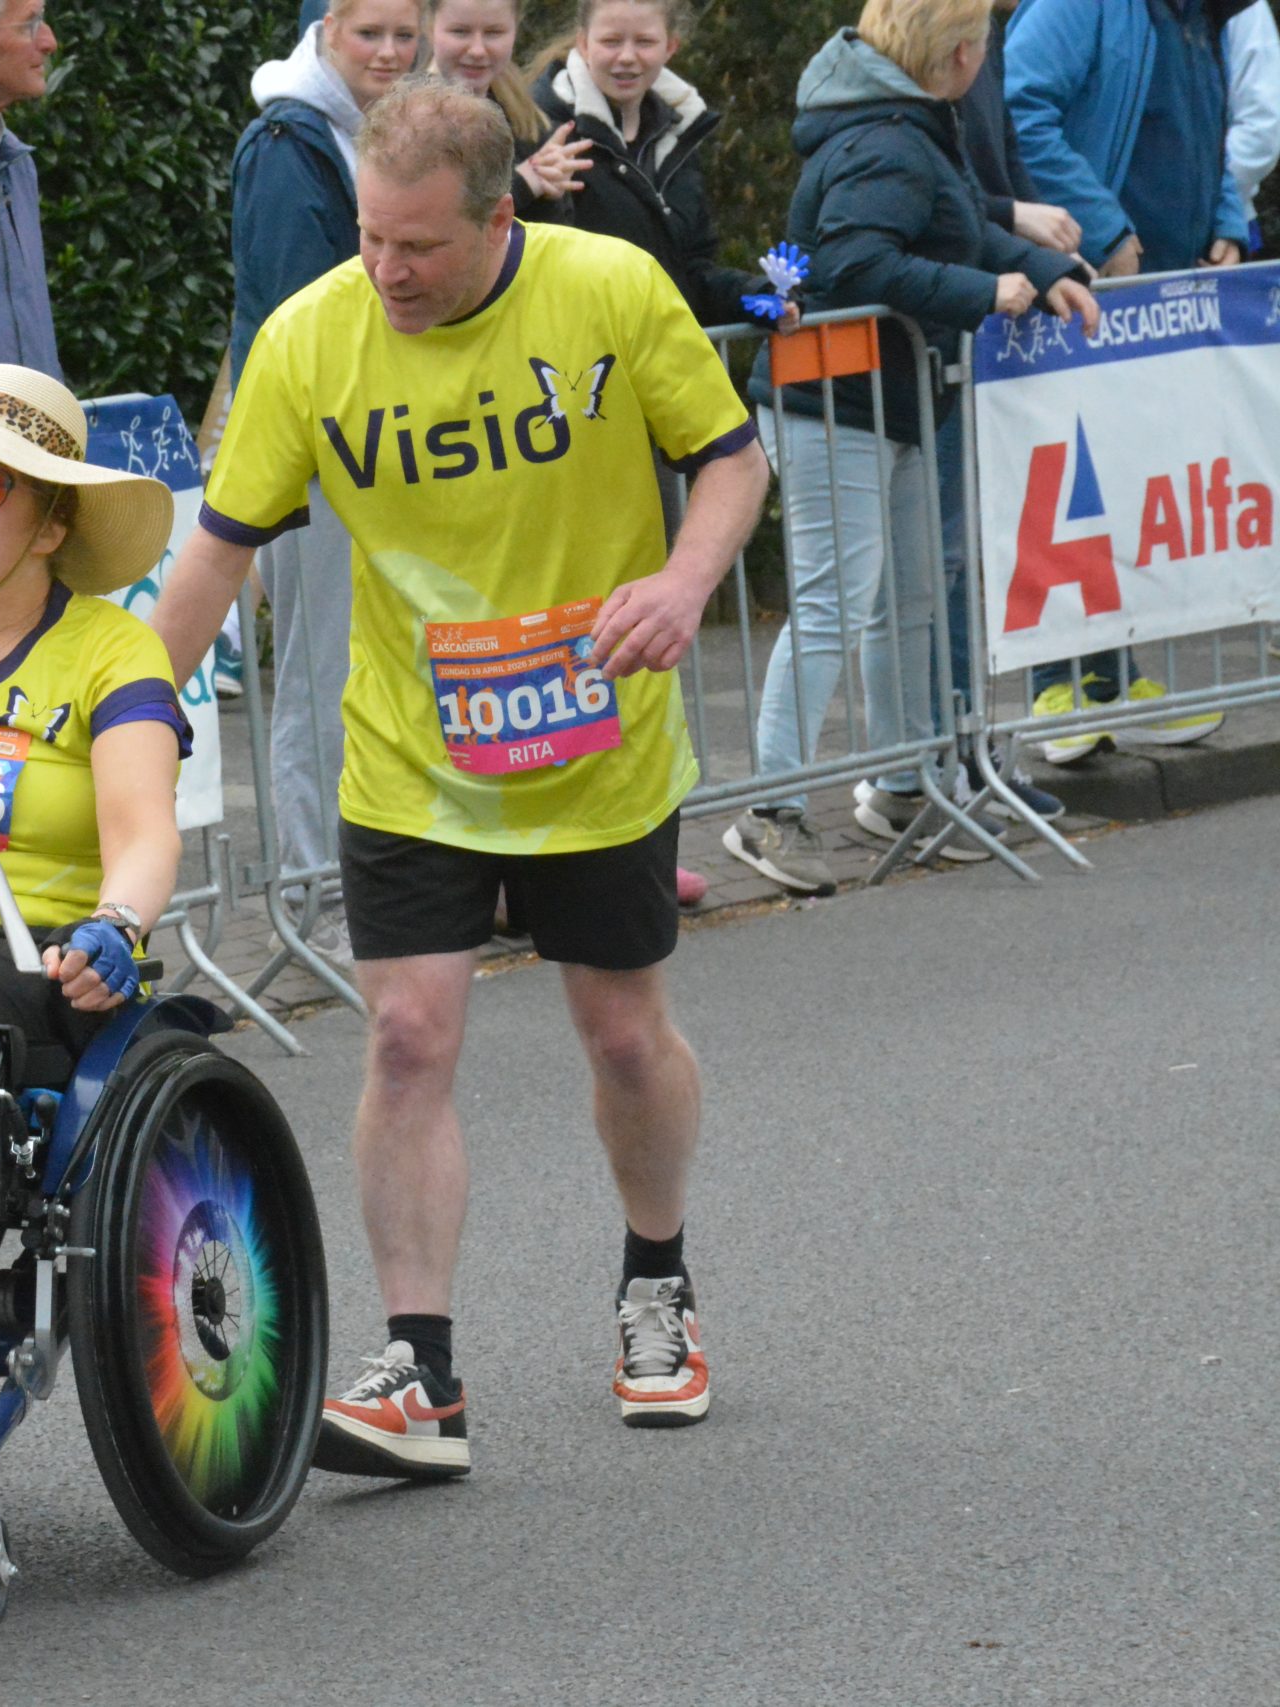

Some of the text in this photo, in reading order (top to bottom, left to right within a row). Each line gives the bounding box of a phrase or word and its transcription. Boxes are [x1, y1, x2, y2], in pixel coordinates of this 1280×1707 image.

[1087, 297, 1222, 348] ASCADERUN
[321, 390, 571, 489] Visio
[1135, 457, 1273, 568] Alfa
[432, 640, 499, 653] CASCADERUN
[483, 665, 505, 674] APRIL
[439, 669, 610, 735] 10016
[508, 740, 555, 765] RITA
